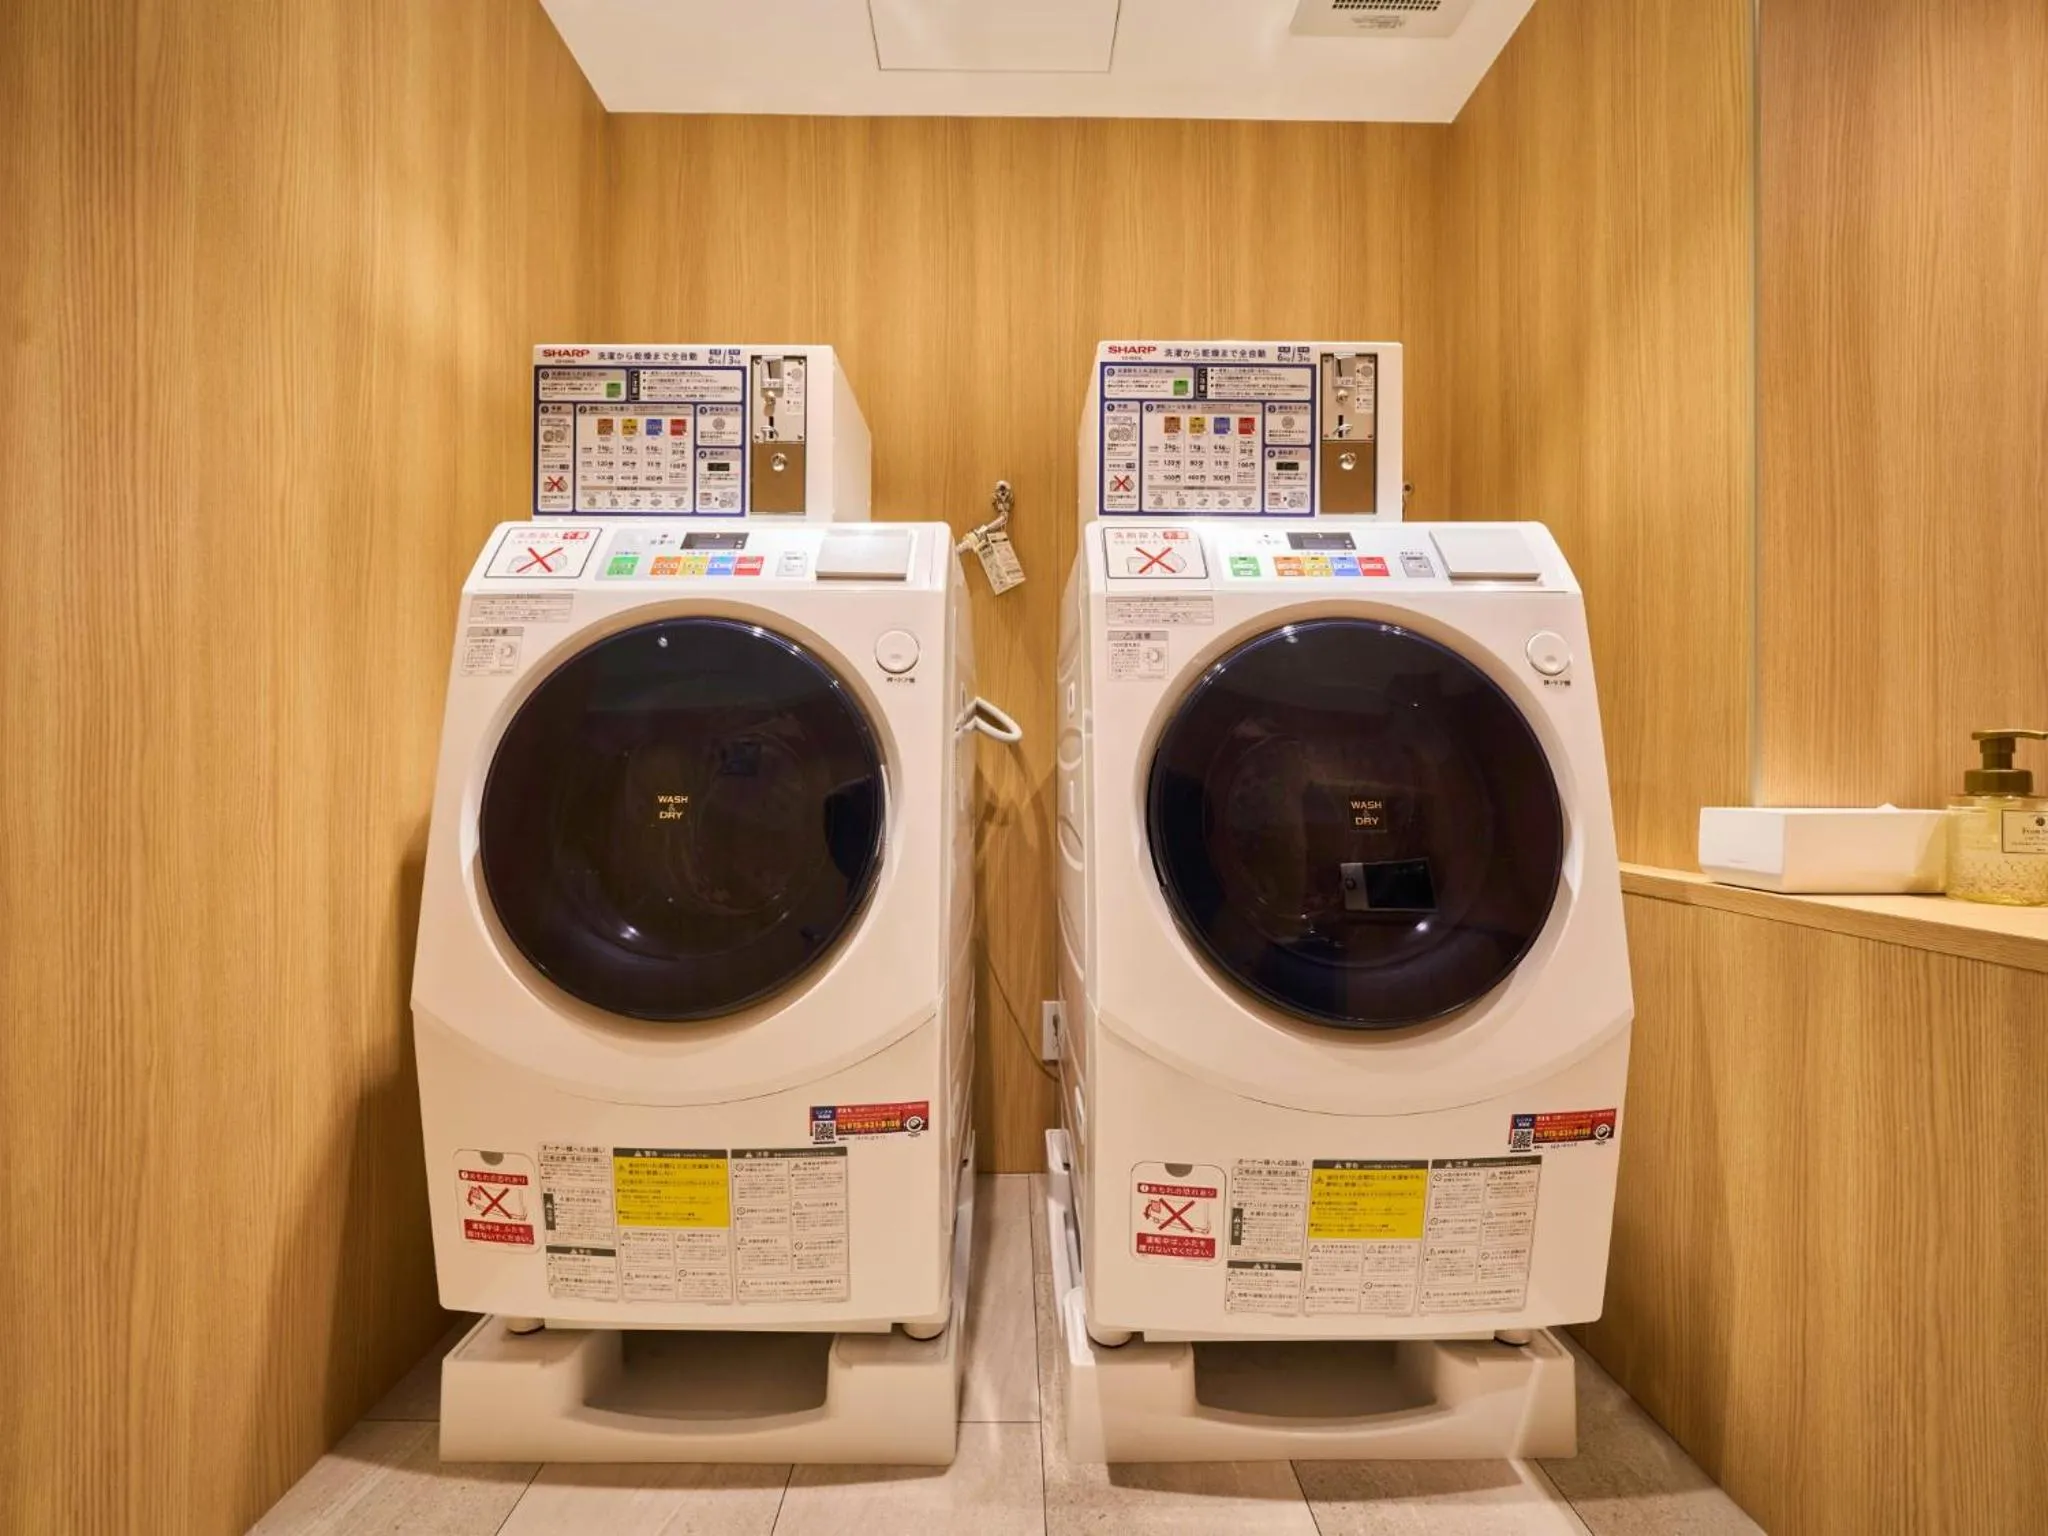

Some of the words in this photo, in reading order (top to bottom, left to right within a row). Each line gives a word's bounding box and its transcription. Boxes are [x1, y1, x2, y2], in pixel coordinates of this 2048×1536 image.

[542, 349, 590, 358] SHARP
[1108, 345, 1157, 354] SHARP
[1164, 348, 1267, 358] 洗濯から乾燥まで全自動
[597, 351, 698, 360] 洗濯から乾燥まで全自動
[657, 795, 688, 804] WASH
[1351, 800, 1382, 809] WASH
[659, 811, 683, 820] DRY
[1355, 817, 1379, 826] DRY
